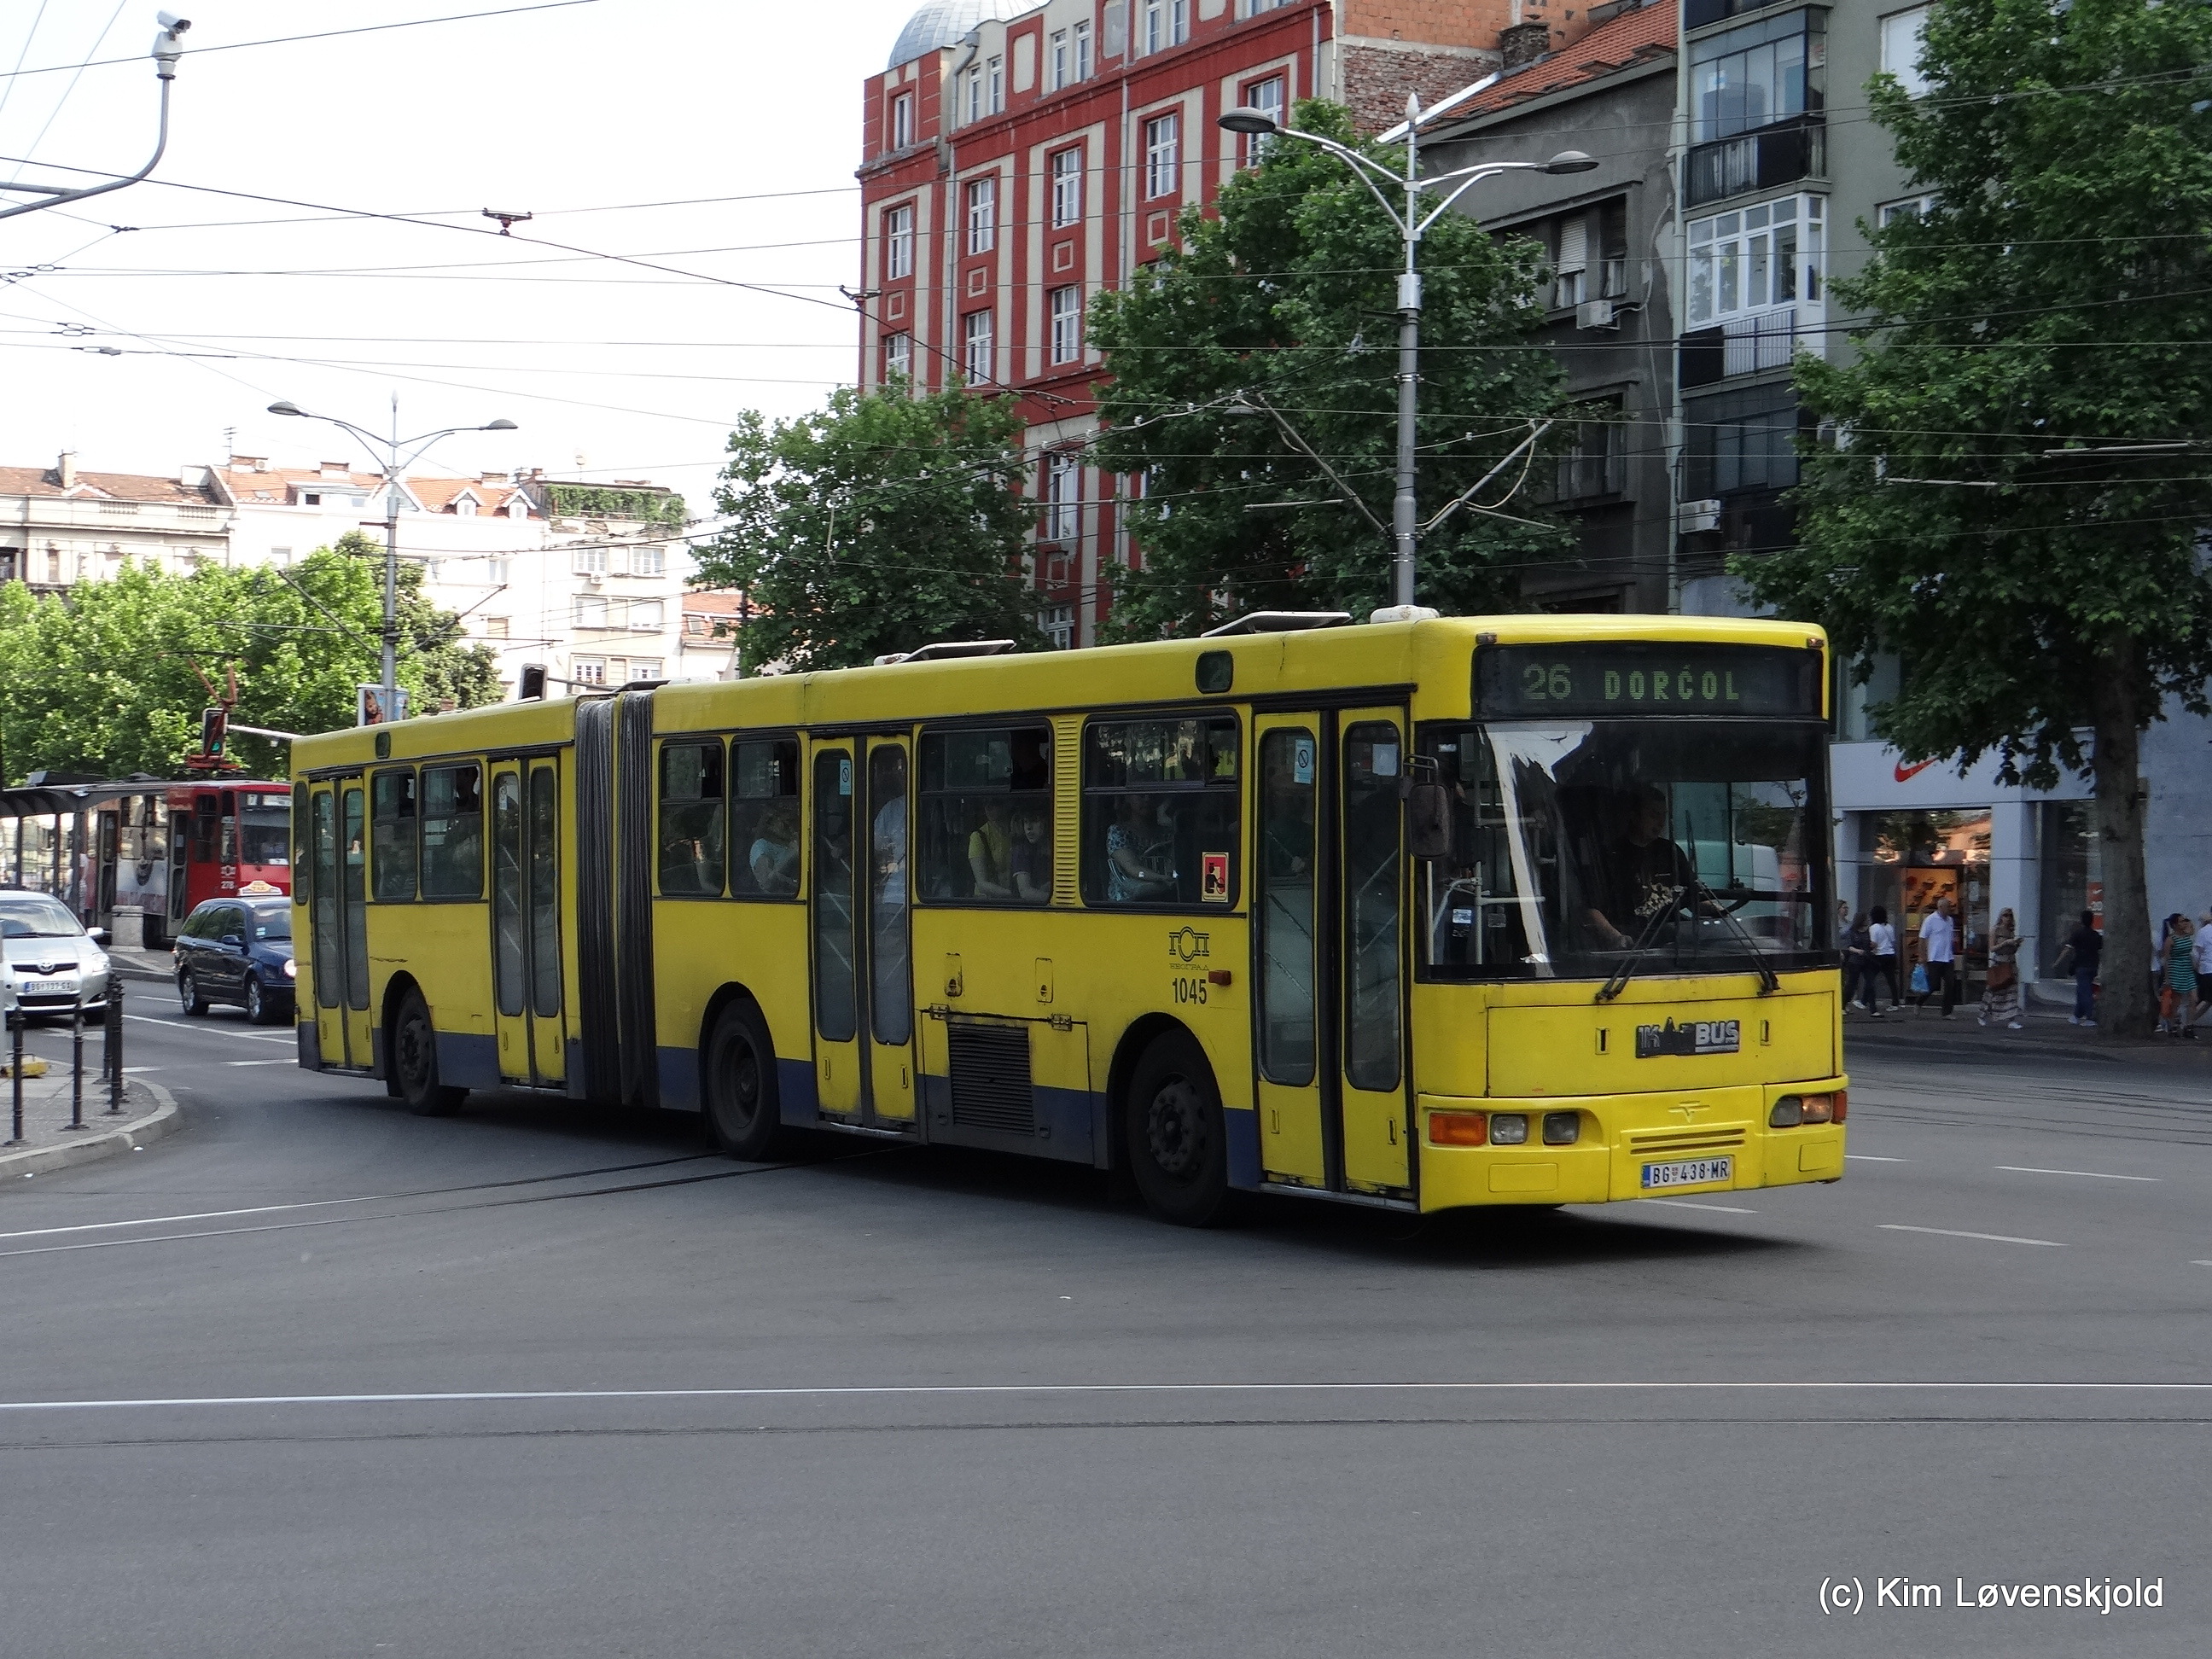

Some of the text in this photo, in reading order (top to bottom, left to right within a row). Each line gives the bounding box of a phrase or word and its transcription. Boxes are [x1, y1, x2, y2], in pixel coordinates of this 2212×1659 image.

[1523, 663, 1571, 700] 26
[1172, 977, 1208, 1005] 1045
[1652, 1166, 1670, 1185] BG
